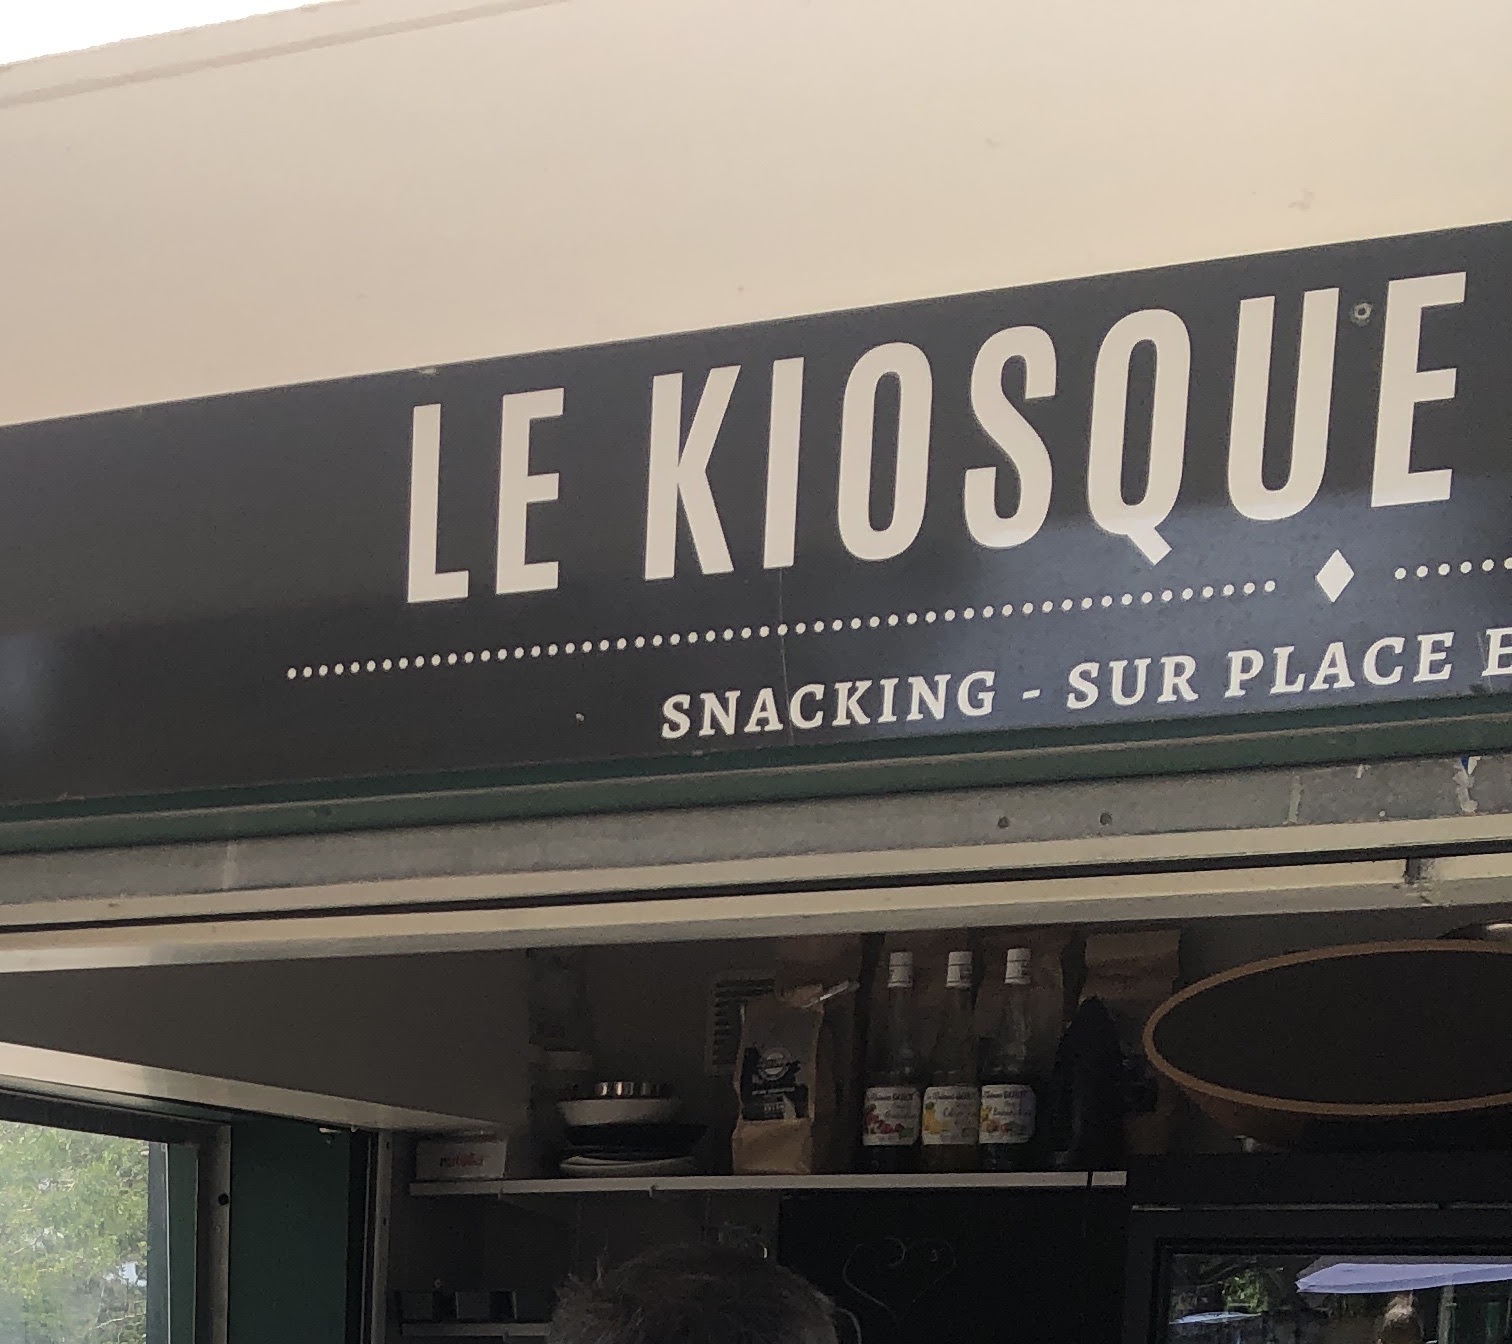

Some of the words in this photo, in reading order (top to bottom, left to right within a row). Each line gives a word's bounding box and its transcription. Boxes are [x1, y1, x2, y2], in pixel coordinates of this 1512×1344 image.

[405, 386, 565, 604] LE
[643, 269, 1468, 583] KIOSQUE
[660, 669, 997, 740] SNACKING
[1020, 686, 1041, 700] -
[1065, 654, 1201, 710] SUR
[1223, 630, 1456, 701] PLACE
